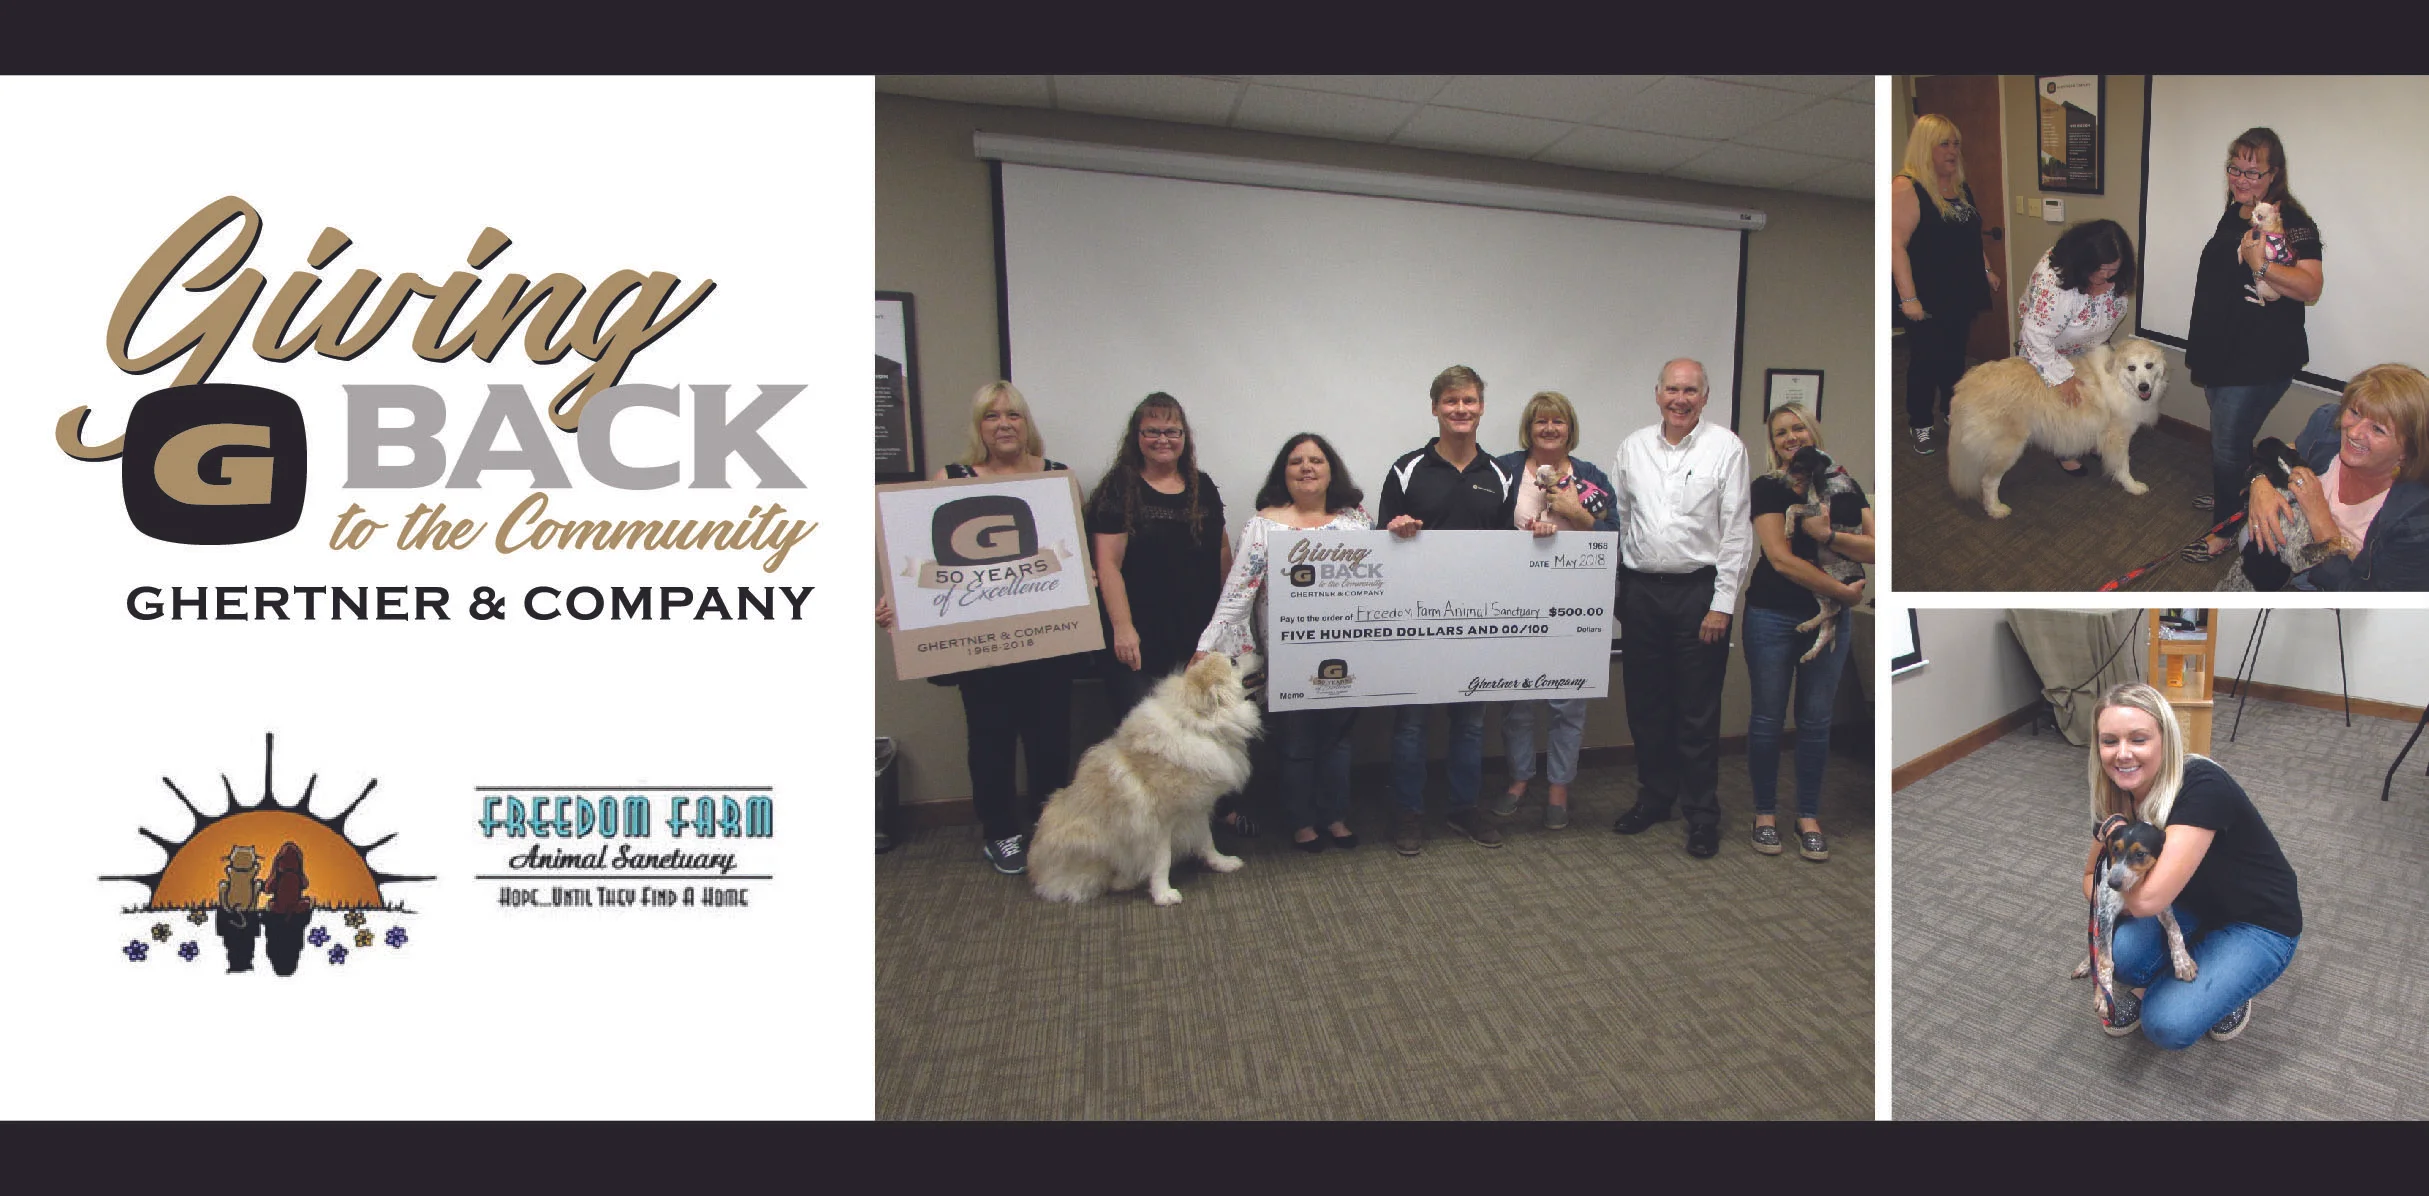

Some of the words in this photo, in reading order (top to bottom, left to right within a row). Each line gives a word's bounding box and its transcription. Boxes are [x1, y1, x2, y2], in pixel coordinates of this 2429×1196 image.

[950, 514, 1021, 560] G
[1588, 542, 1608, 550] 1968
[1280, 538, 1373, 577] Giving
[1529, 560, 1550, 568] DATE
[935, 570, 964, 584] 50
[972, 559, 1049, 583] YEARS
[1320, 563, 1384, 580] BACK
[933, 584, 956, 618] of
[958, 577, 1061, 607] Excellence
[1290, 590, 1336, 598] GHERTNER
[1344, 589, 1384, 597] COMPANY
[1416, 599, 1441, 618] Farm
[1443, 600, 1487, 618] Animal
[1491, 602, 1541, 619] Sanctuary
[1548, 606, 1604, 618] $500.00
[1280, 615, 1295, 625] Pay
[1296, 615, 1305, 623] to
[1306, 615, 1320, 623] the
[1321, 614, 1342, 622] order
[1344, 613, 1355, 621] of
[917, 633, 996, 653] GHERTNER
[1000, 631, 1011, 641] &
[1014, 620, 1080, 640] COMPANY
[1280, 630, 1316, 641] FIVE
[1320, 627, 1393, 640] HUNDRED
[1396, 625, 1464, 638] DOLLARS
[1467, 625, 1499, 636] AND
[1501, 624, 1549, 635] 00/100
[1576, 625, 1602, 633] Dollars
[1464, 676, 1520, 697] Ghertner
[1521, 678, 1533, 689] &
[1534, 673, 1587, 691] Company
[1280, 692, 1305, 700] Memo
